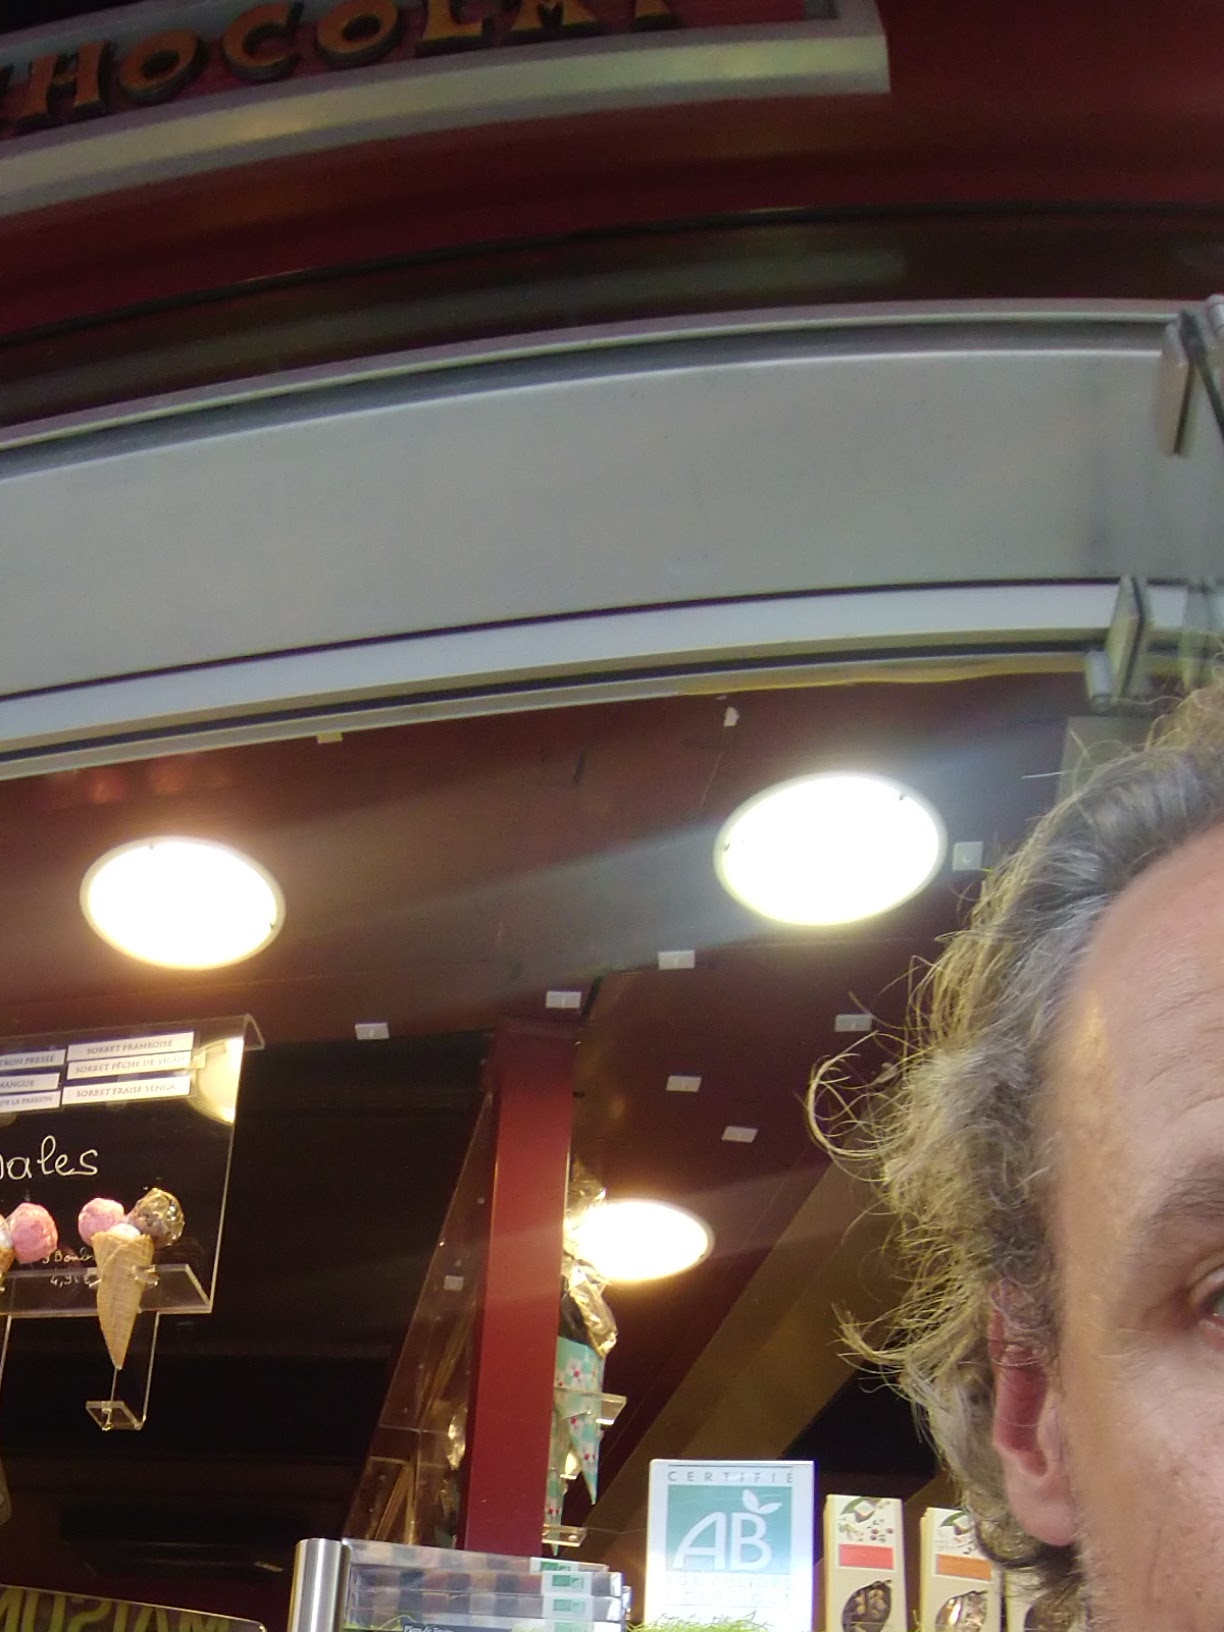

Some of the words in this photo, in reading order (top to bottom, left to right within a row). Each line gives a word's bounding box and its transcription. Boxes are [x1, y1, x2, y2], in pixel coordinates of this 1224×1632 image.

[87, 1045, 120, 1055] SORBET
[122, 1040, 172, 1052] FRAMBOISE
[76, 1064, 110, 1074] SORBET
[76, 1087, 110, 1098] SORBET
[112, 1085, 142, 1096] FRAISE
[11, 1098, 23, 1106] LA
[673, 1511, 773, 1571] AB
